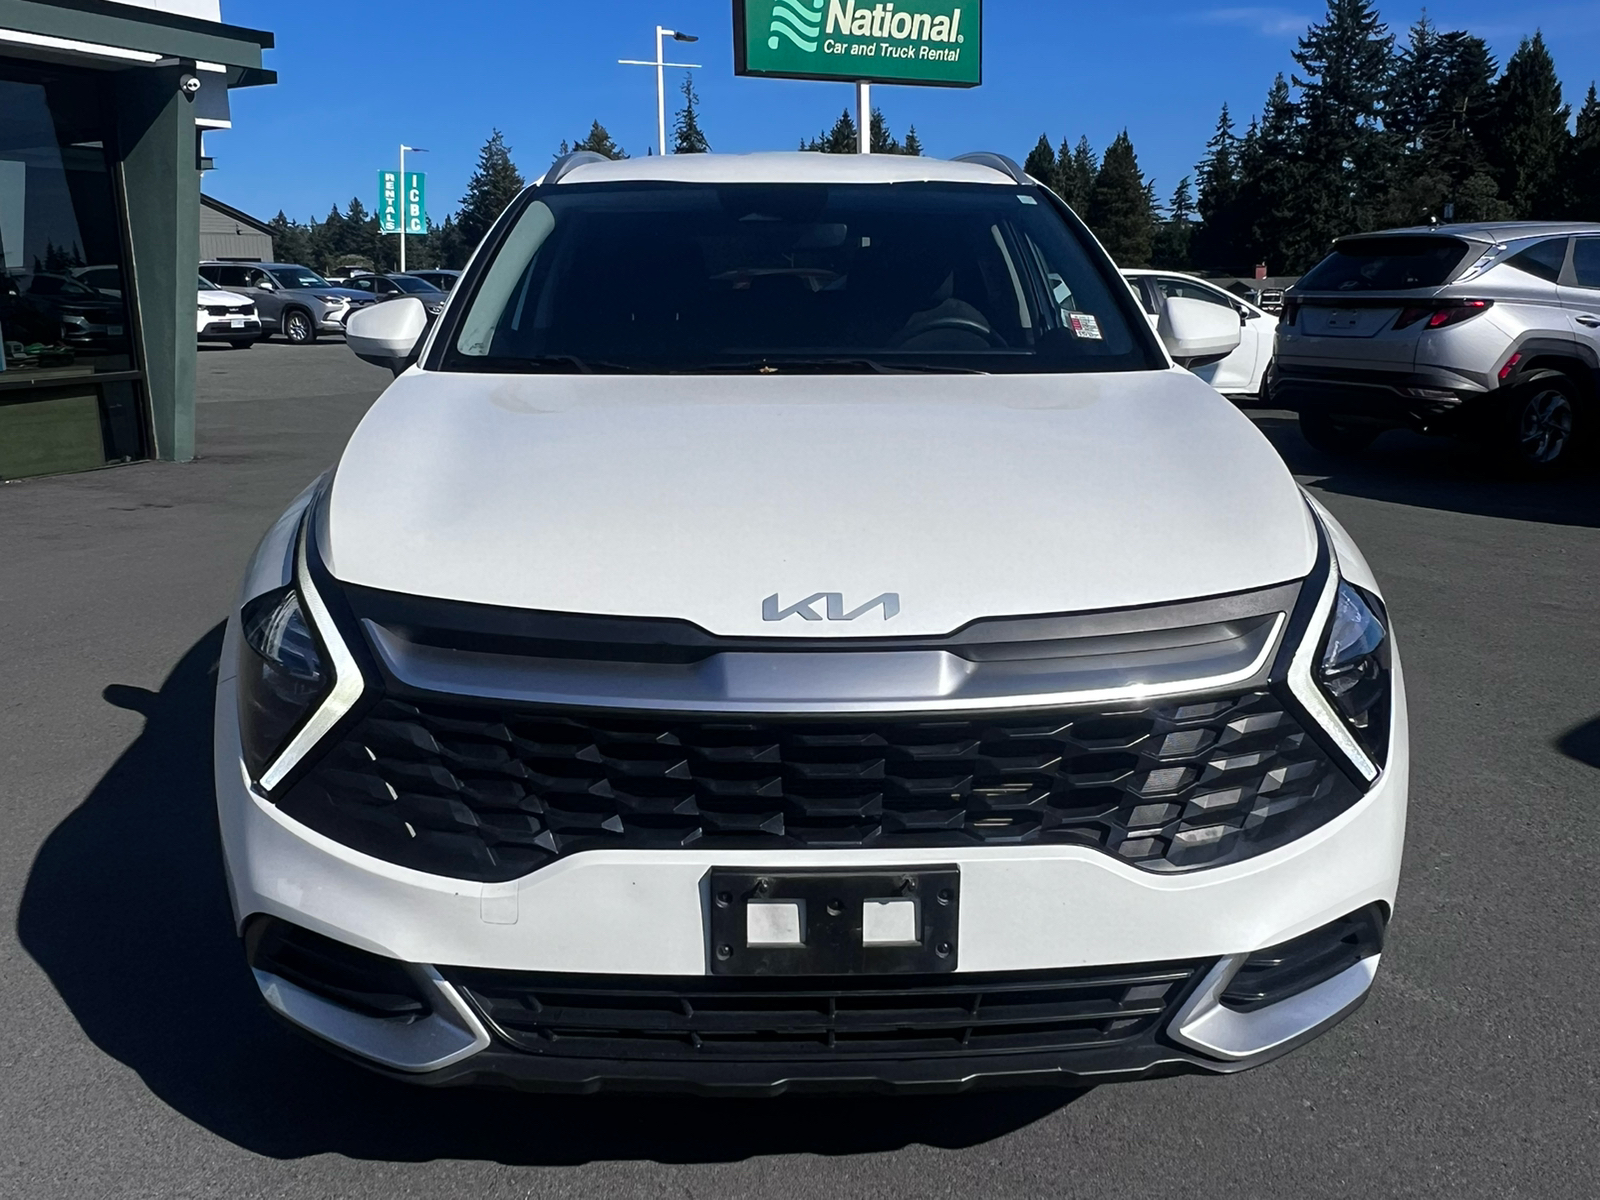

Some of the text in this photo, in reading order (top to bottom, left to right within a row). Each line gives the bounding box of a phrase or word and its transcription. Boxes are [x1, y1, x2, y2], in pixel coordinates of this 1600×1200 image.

[825, 0, 961, 43] National
[823, 39, 960, 61] Car and Truck Rental
[384, 172, 395, 231] RENTALS
[409, 174, 421, 231] ICBC
[762, 592, 900, 621] KIA
